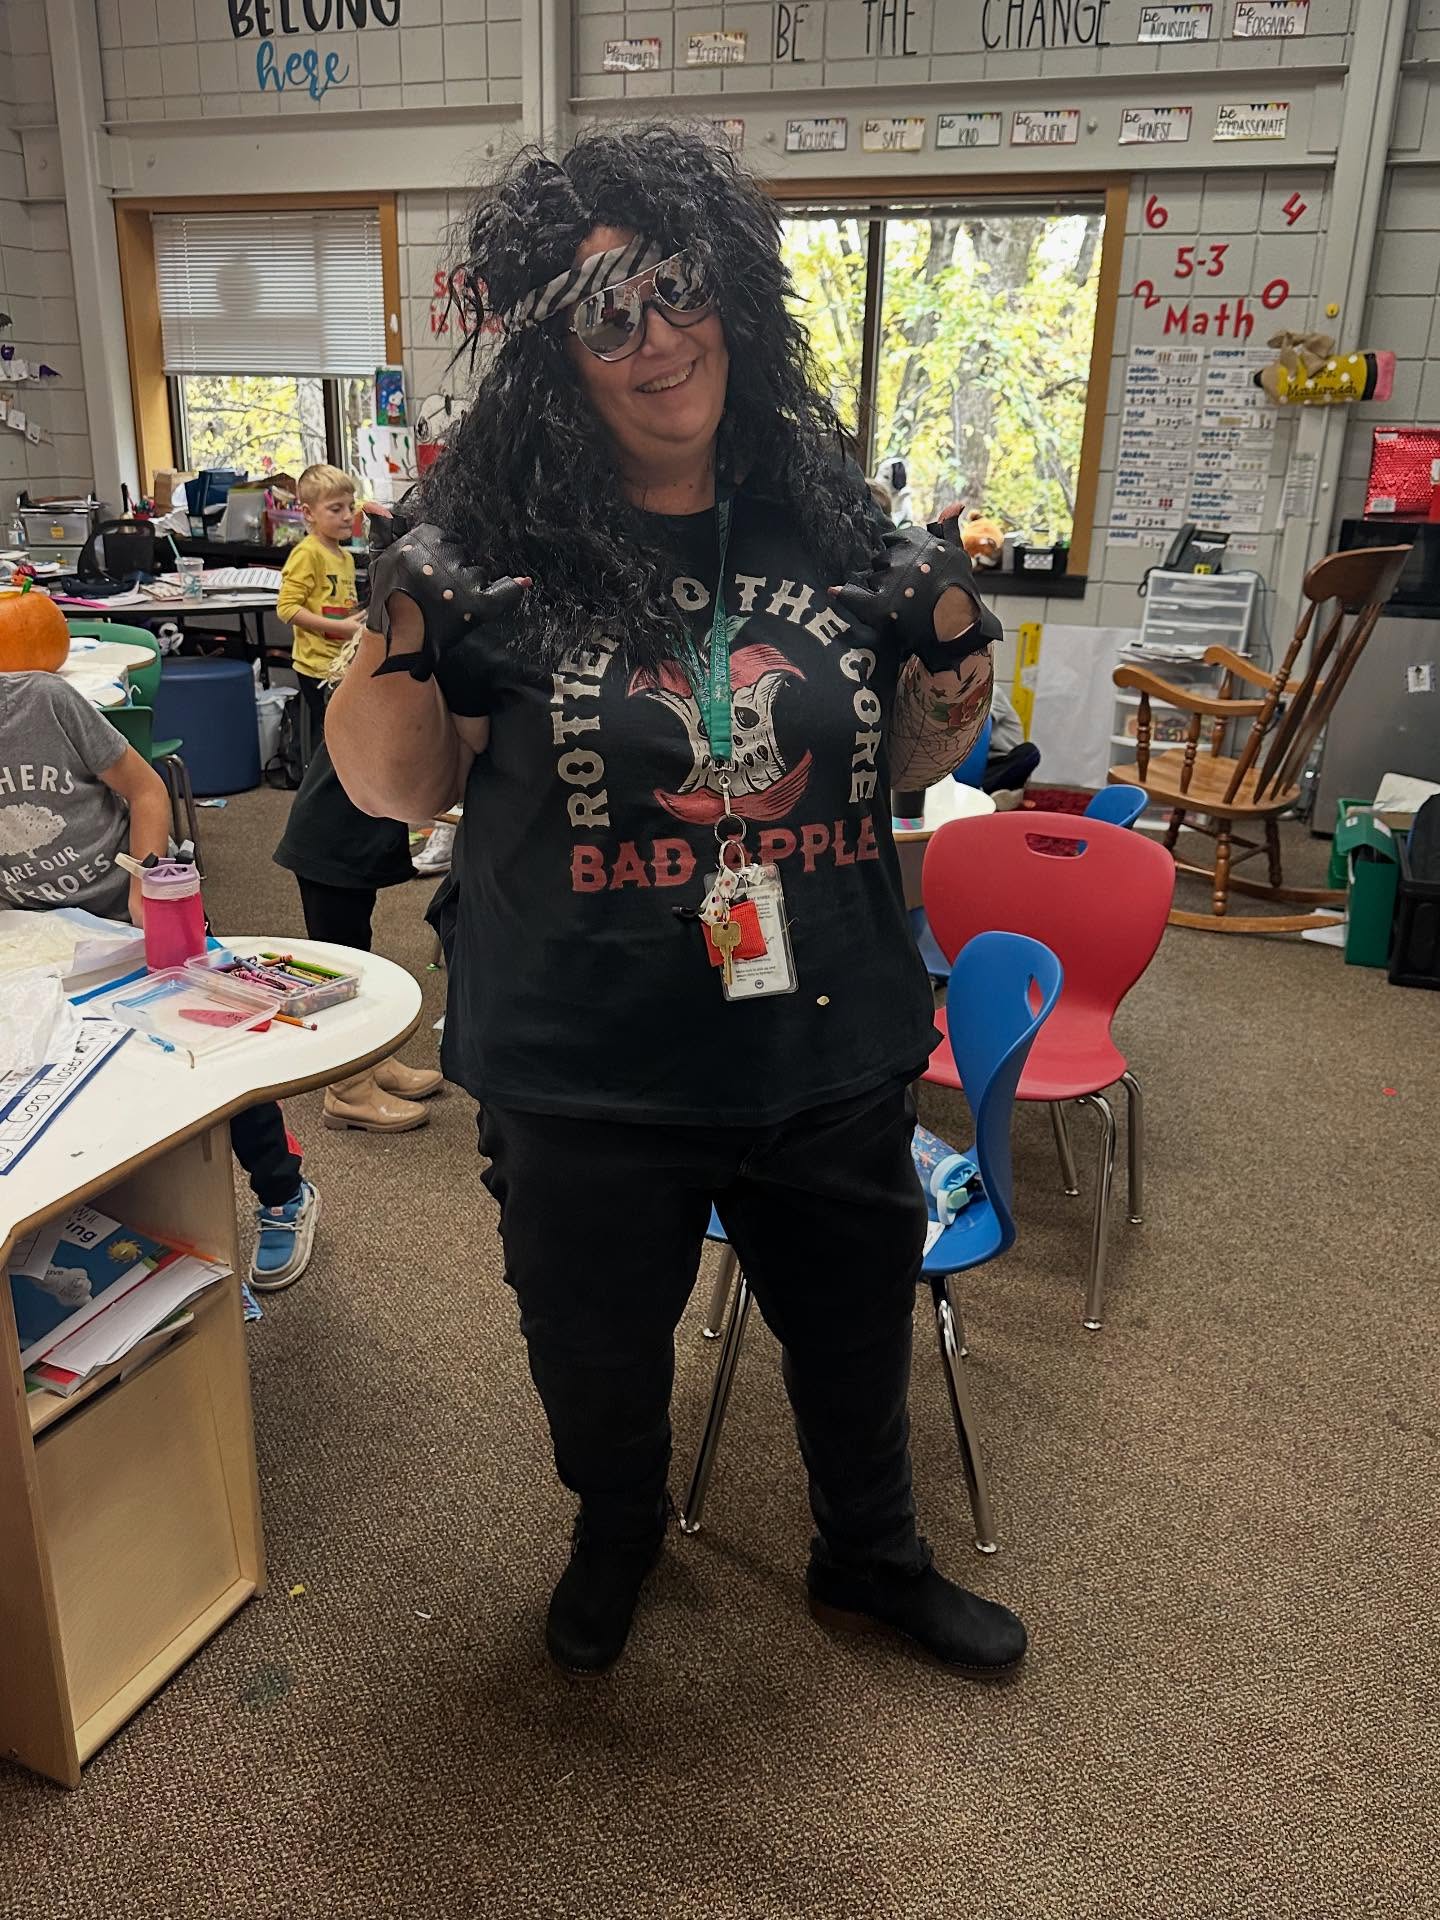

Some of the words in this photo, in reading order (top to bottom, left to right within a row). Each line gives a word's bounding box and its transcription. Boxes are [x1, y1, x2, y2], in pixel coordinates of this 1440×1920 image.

[228, 0, 400, 37] BELONG
[1143, 9, 1161, 22] be
[1238, 3, 1256, 17] be
[776, 4, 809, 61] BE
[862, 0, 917, 56] THE
[982, 0, 1110, 48] CHANGE
[1246, 16, 1295, 36] FORGIVING
[256, 41, 349, 100] here
[940, 117, 955, 128] be
[1016, 113, 1032, 126] be
[1124, 111, 1141, 123] be
[1219, 107, 1238, 119] be
[789, 122, 802, 133] be
[865, 122, 880, 133] be
[1025, 124, 1067, 143] RESILIENT
[1137, 122, 1172, 141] HONEST
[1216, 118, 1285, 134] COMPASSIONATE
[882, 131, 907, 150] SAFE
[958, 127, 979, 146] KIND
[1146, 194, 1168, 229] 6
[1282, 192, 1307, 226] 4
[1133, 279, 1161, 309] 2
[1163, 296, 1255, 338] Math
[1213, 350, 1245, 360] compare
[1121, 451, 1151, 459] doubles
[1197, 451, 1219, 459] count
[671, 575, 710, 612] O
[735, 573, 851, 646] THE
[839, 648, 882, 803] CORE
[2, 862, 37, 885] ARE
[40, 846, 80, 871] OUR
[569, 838, 697, 893] BAD
